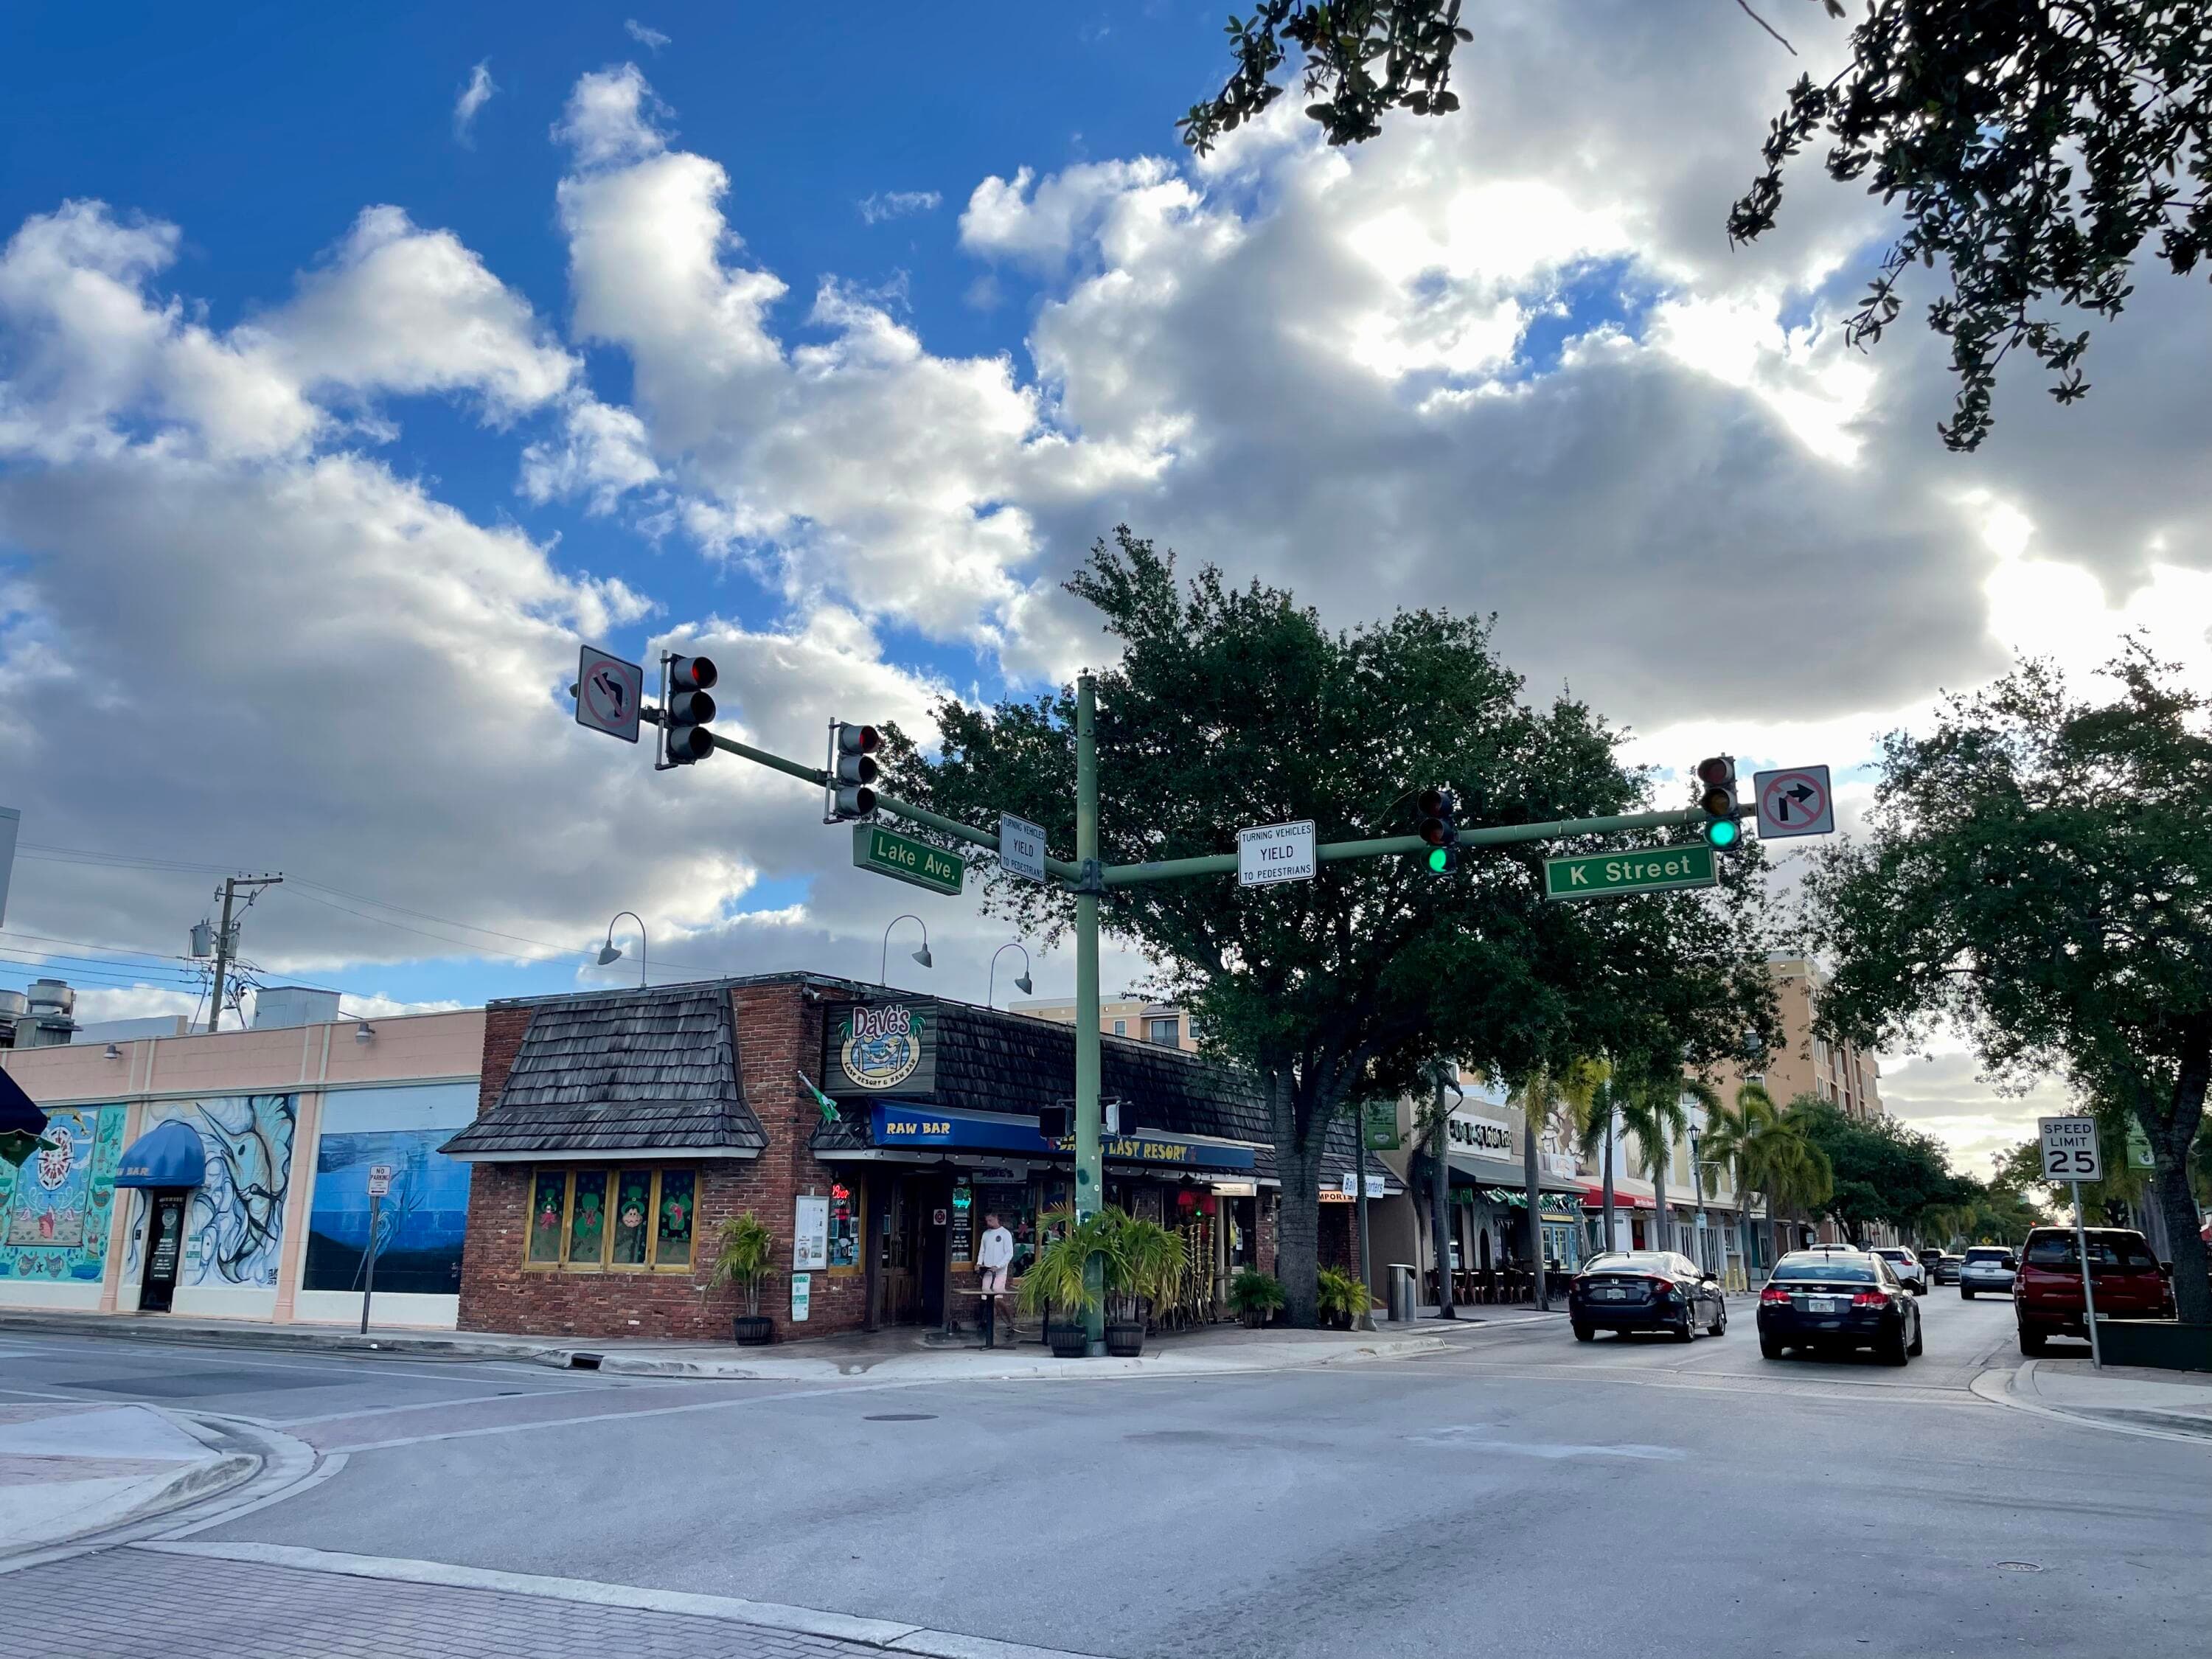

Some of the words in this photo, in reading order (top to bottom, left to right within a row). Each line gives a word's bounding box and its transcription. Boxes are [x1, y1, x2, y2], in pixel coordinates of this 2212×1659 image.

[1004, 817, 1022, 831] TURNING
[1023, 825, 1044, 840] VEHICLES
[1242, 830, 1273, 842] TURNING
[1276, 825, 1311, 838] VEHICLES
[1013, 838, 1034, 857] YIELD
[1260, 845, 1293, 861] YIELD
[877, 837, 916, 866] Lake
[924, 854, 956, 880] Ave.
[1004, 856, 1009, 866] TO
[1011, 860, 1043, 878] PEDESTRIANS
[1245, 872, 1253, 880] TO
[1257, 864, 1311, 879] PEDESTRIANS
[1571, 866, 1588, 886] K
[1605, 855, 1691, 882] Street
[844, 1062, 857, 1076] LAST
[857, 1076, 882, 1085] RESORT
[891, 1071, 905, 1082] RAW
[905, 1058, 917, 1074] BAR
[886, 1122, 917, 1135] RAW
[922, 1122, 950, 1135] BAR
[2045, 1124, 2092, 1133] SPEED
[1109, 1141, 1141, 1157] LAST
[1144, 1143, 1187, 1162] RESORT
[2051, 1137, 2087, 1147] LIMIT
[2048, 1150, 2095, 1173] 25
